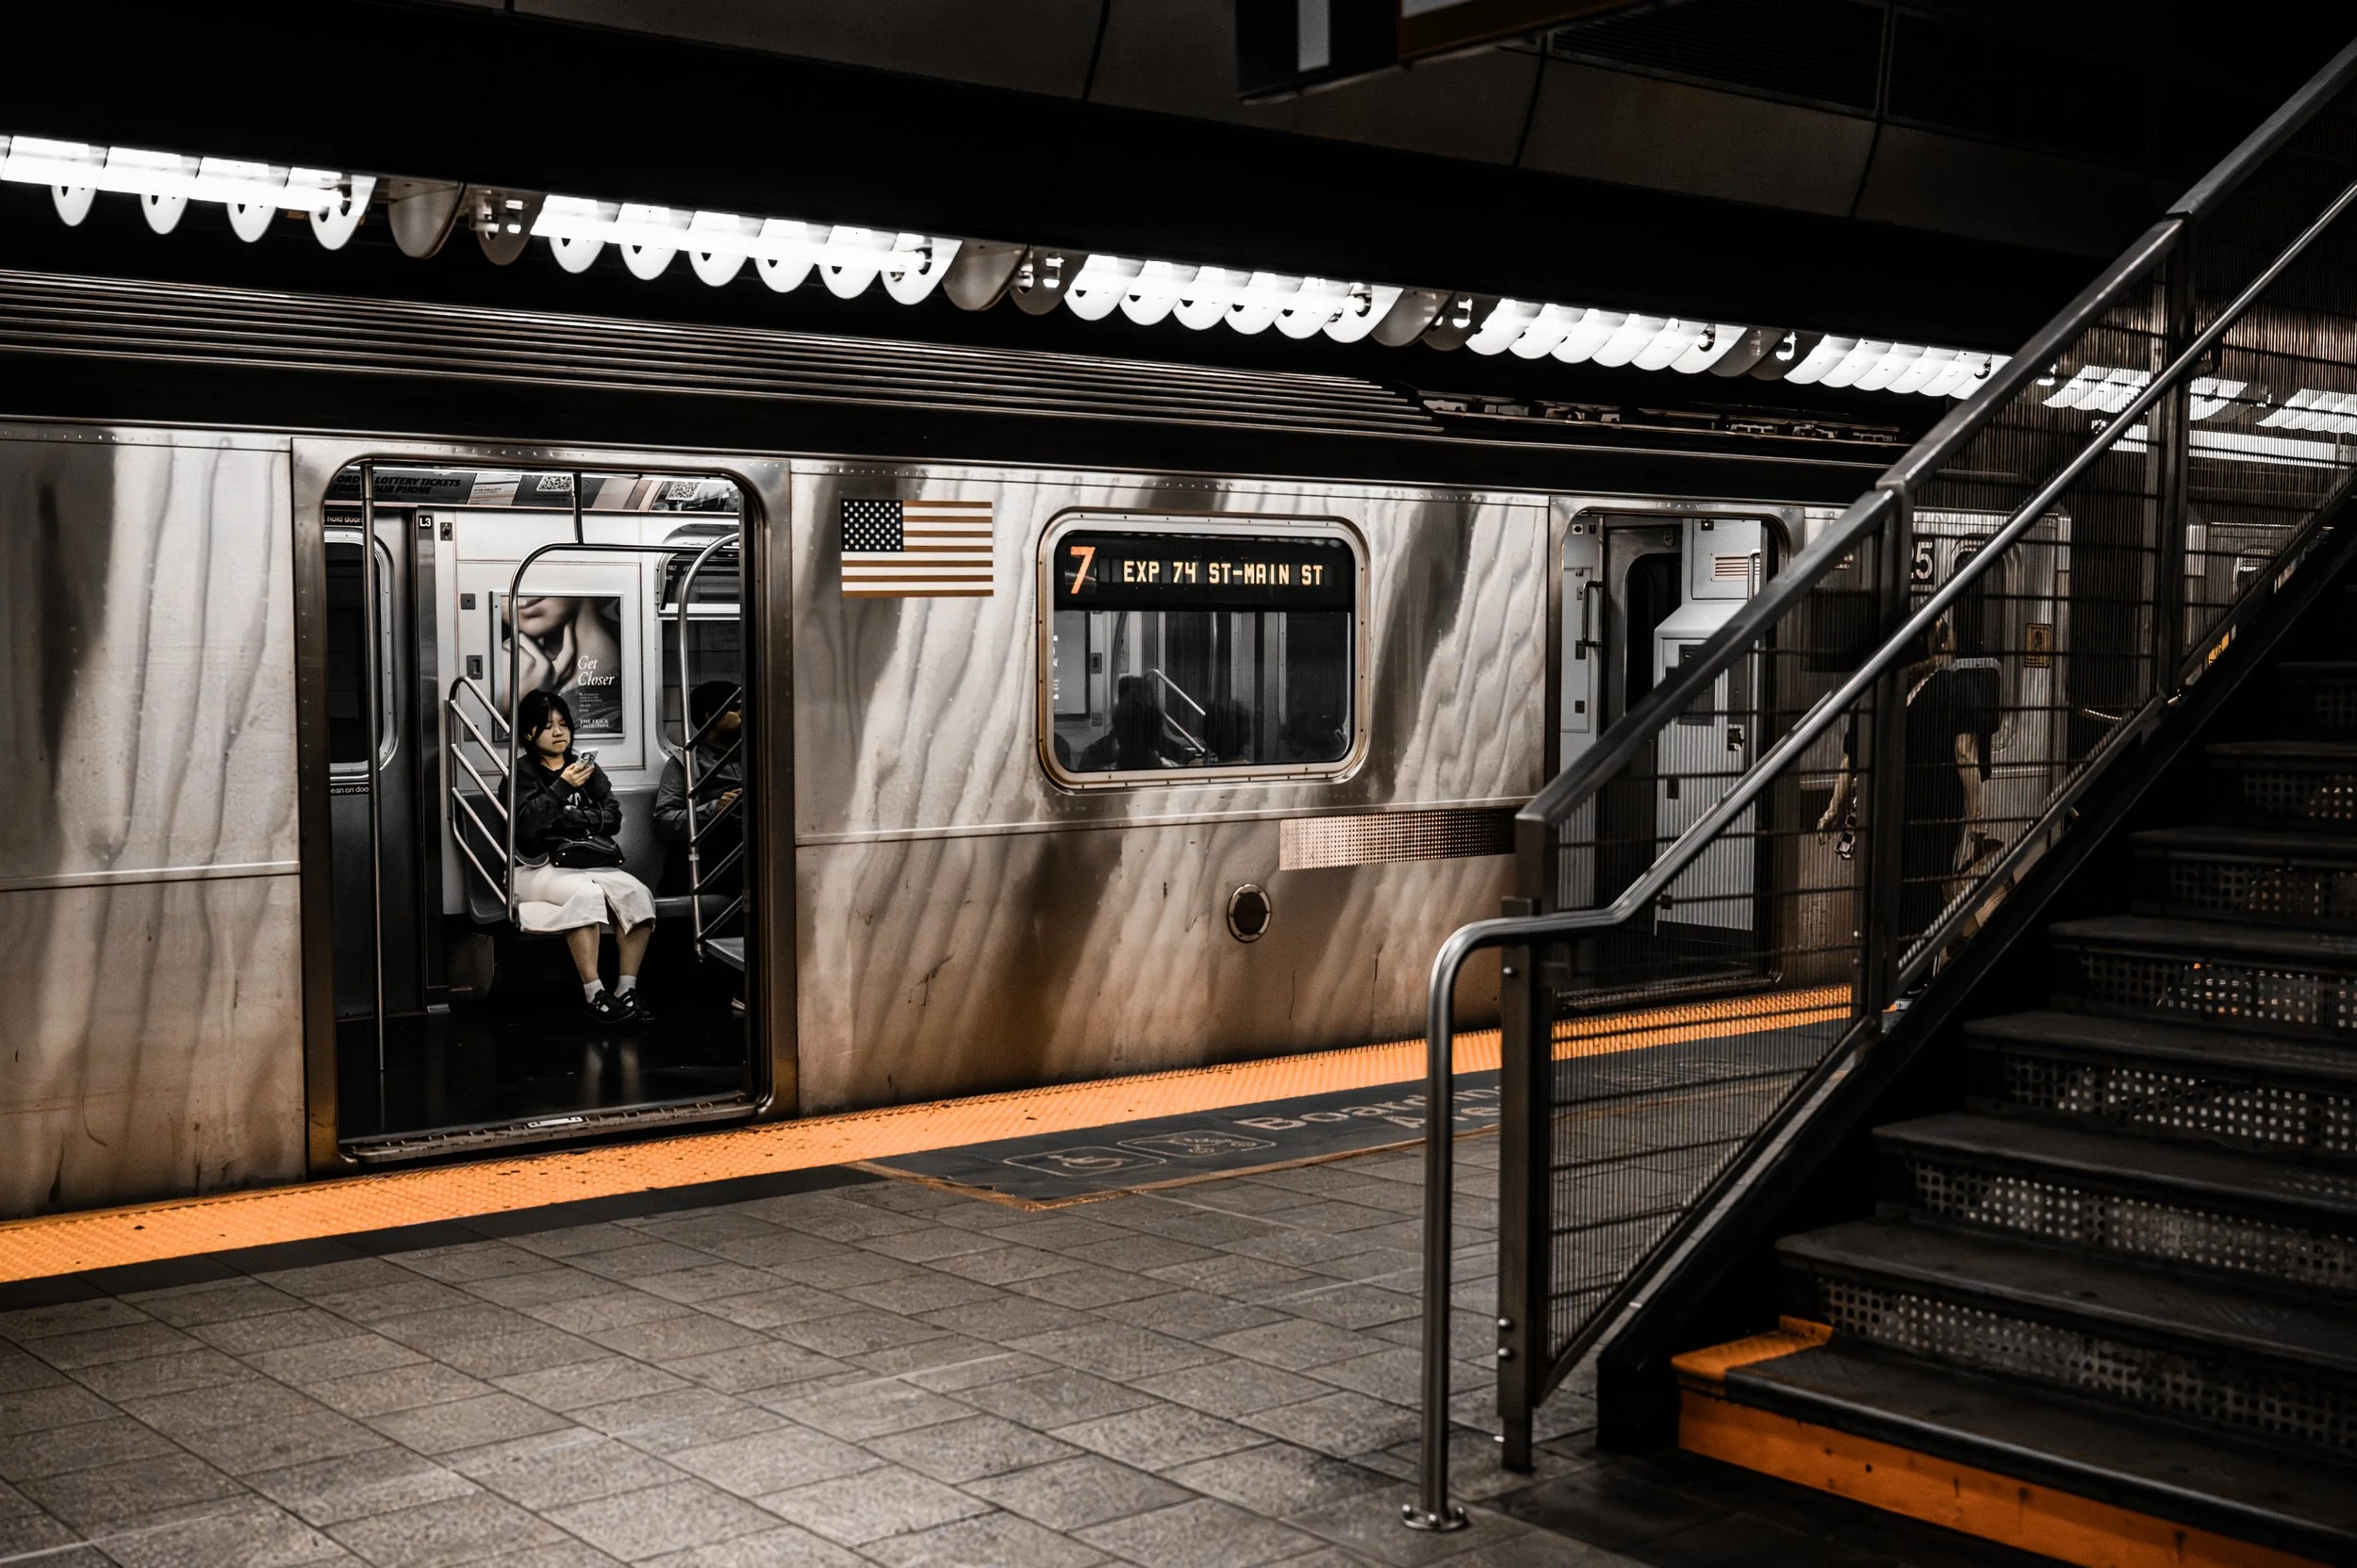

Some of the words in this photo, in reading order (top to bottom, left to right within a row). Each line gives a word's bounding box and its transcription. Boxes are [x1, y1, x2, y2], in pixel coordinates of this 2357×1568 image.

[375, 476, 420, 486] LOTTERY
[420, 478, 461, 487] TICKETS
[395, 486, 432, 494] PHONE
[419, 517, 432, 527] L3
[1070, 546, 1096, 595] 7
[1123, 560, 1160, 583] EXP
[1172, 562, 1196, 584] 74
[1209, 563, 1290, 586] ST-MAIN
[1301, 565, 1323, 586] ST
[577, 655, 598, 669] Get
[577, 670, 616, 686] Closer
